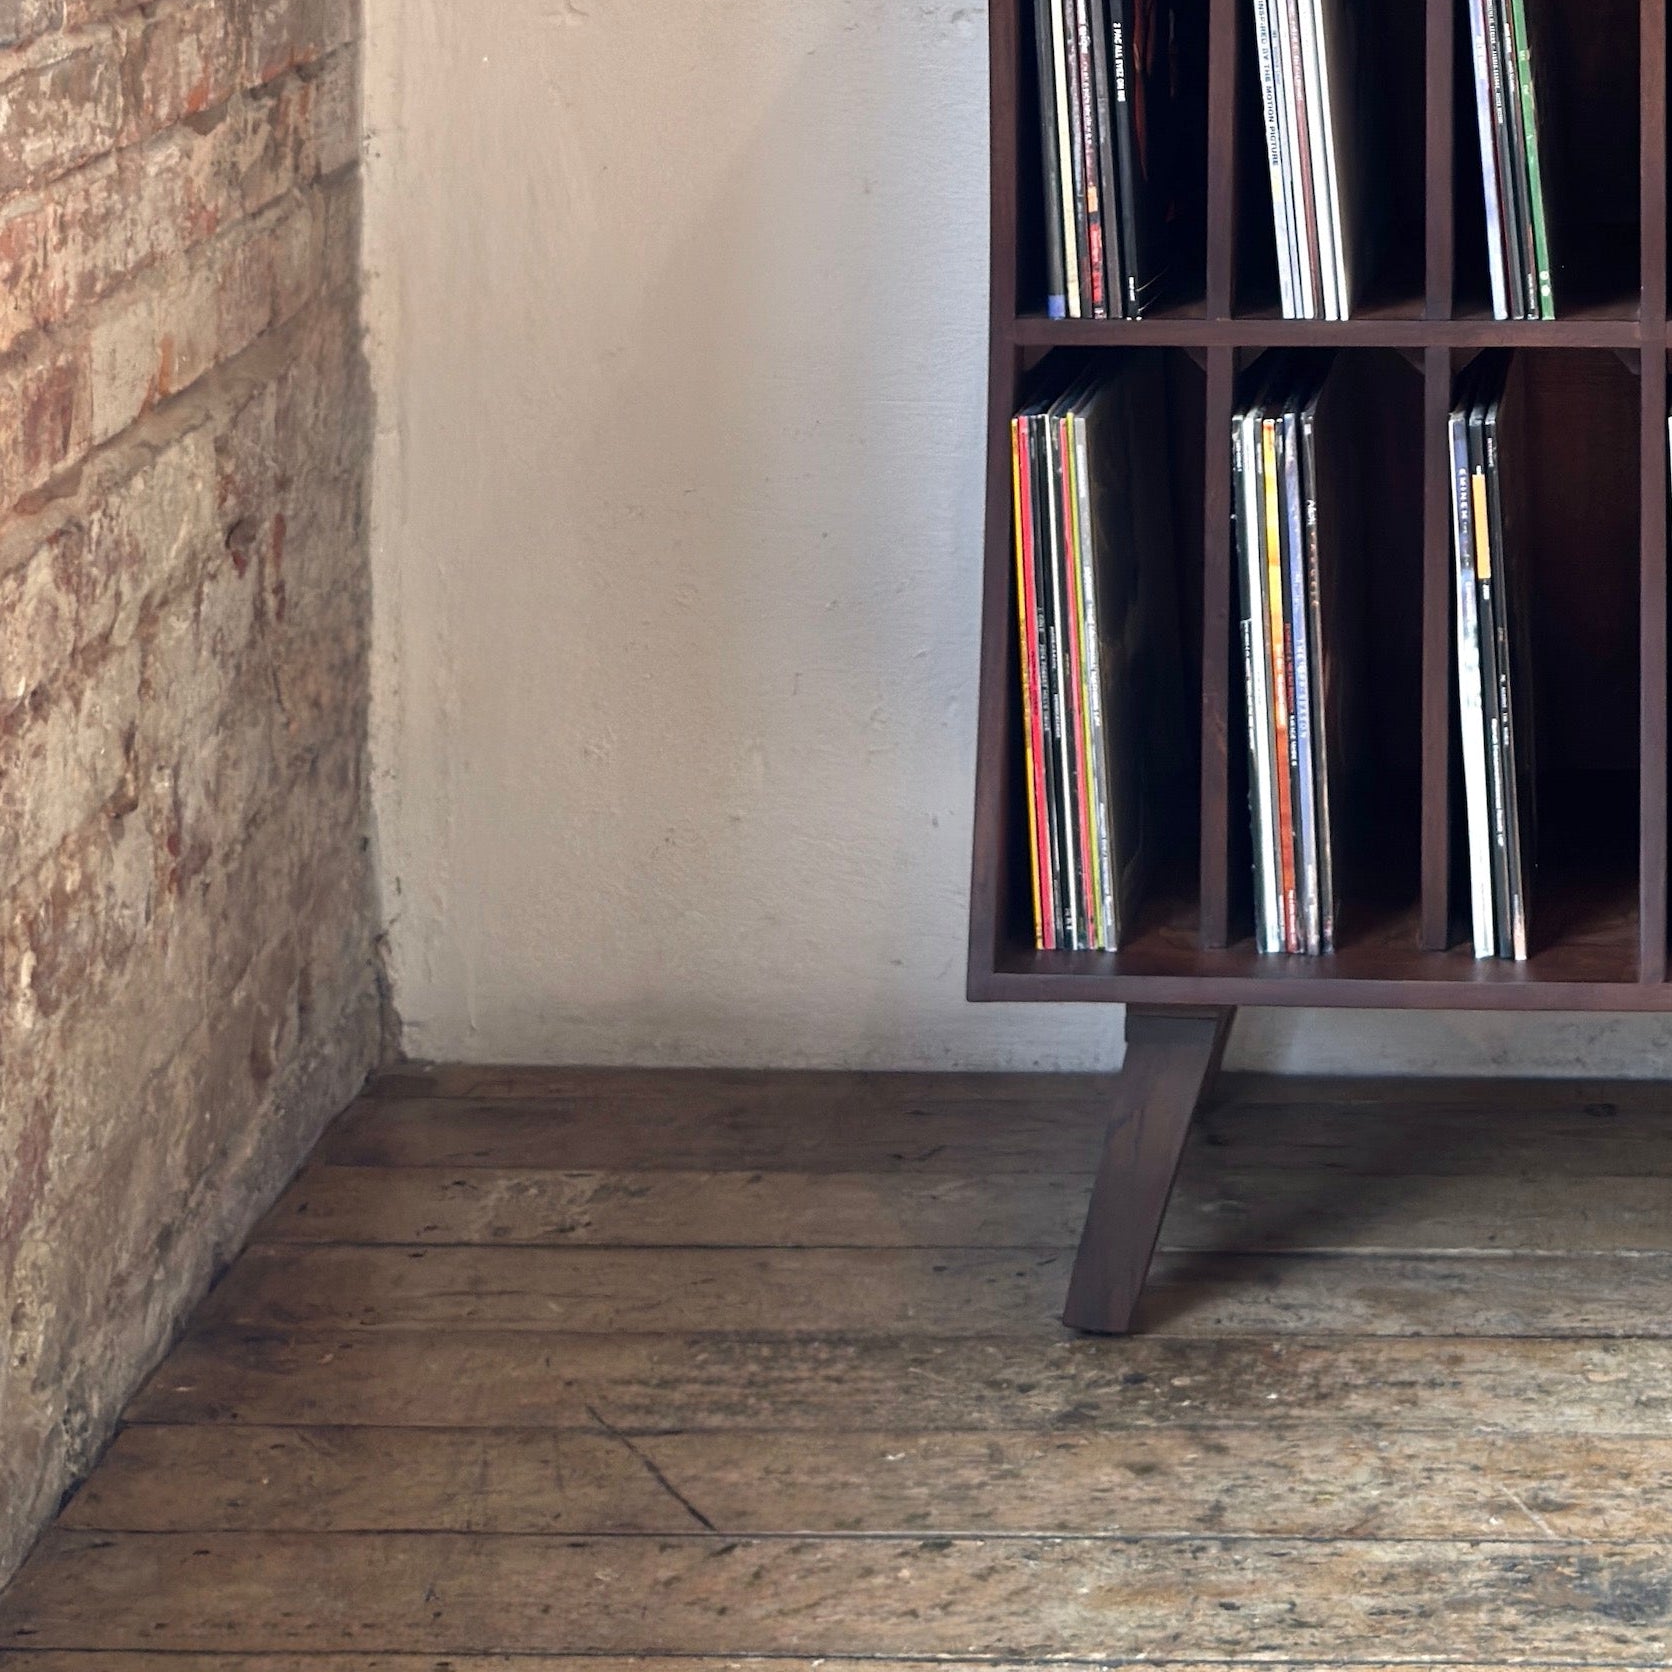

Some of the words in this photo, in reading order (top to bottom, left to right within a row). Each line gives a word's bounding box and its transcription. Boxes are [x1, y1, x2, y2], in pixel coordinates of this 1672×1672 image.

[1115, 44, 1123, 58] ALL
[1115, 59, 1125, 77] EYEZ
[1263, 64, 1271, 82] THE
[1265, 85, 1275, 123] MOTION
[1269, 125, 1279, 166] PICTURE
